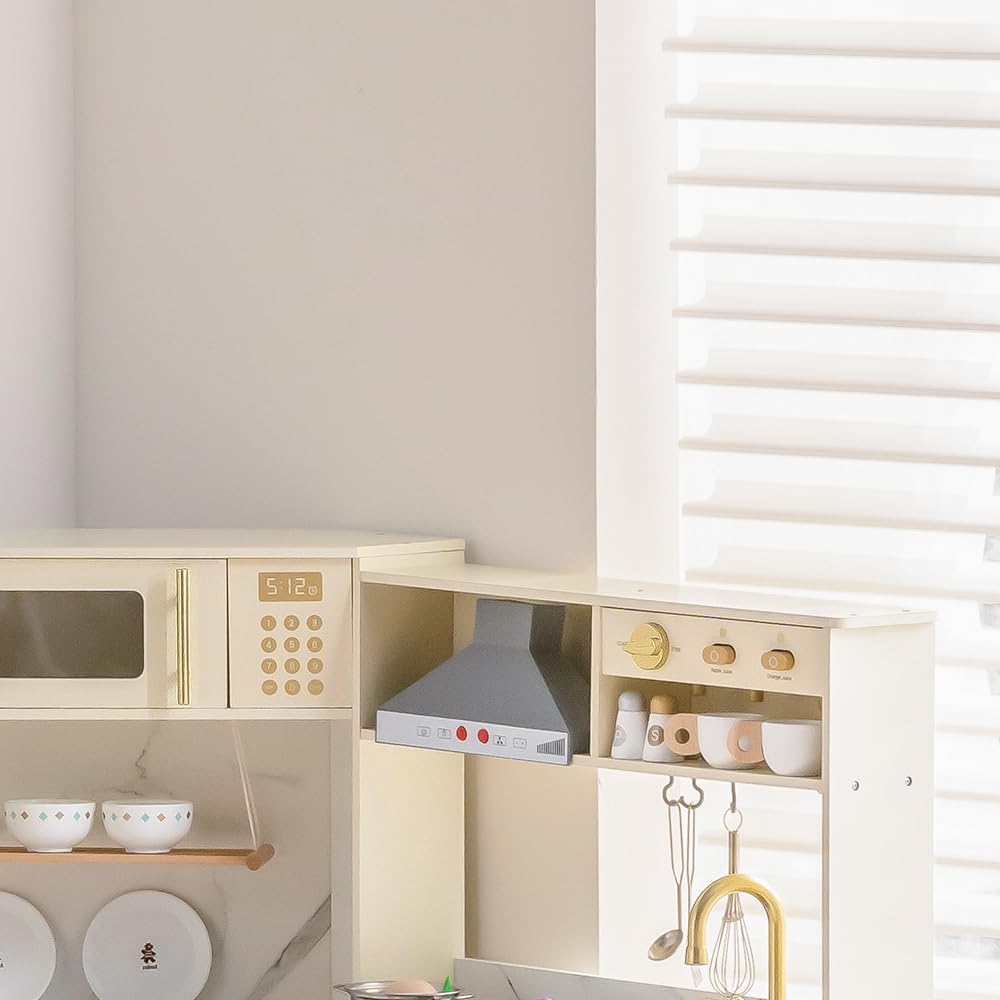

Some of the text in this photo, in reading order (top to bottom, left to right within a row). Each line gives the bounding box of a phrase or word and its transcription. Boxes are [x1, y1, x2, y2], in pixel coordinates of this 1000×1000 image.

[266, 577, 305, 595] 5:12
[288, 618, 294, 628] 2
[311, 618, 318, 627] 3
[265, 640, 272, 649] 4
[312, 640, 318, 649] 6
[266, 661, 272, 670] 7
